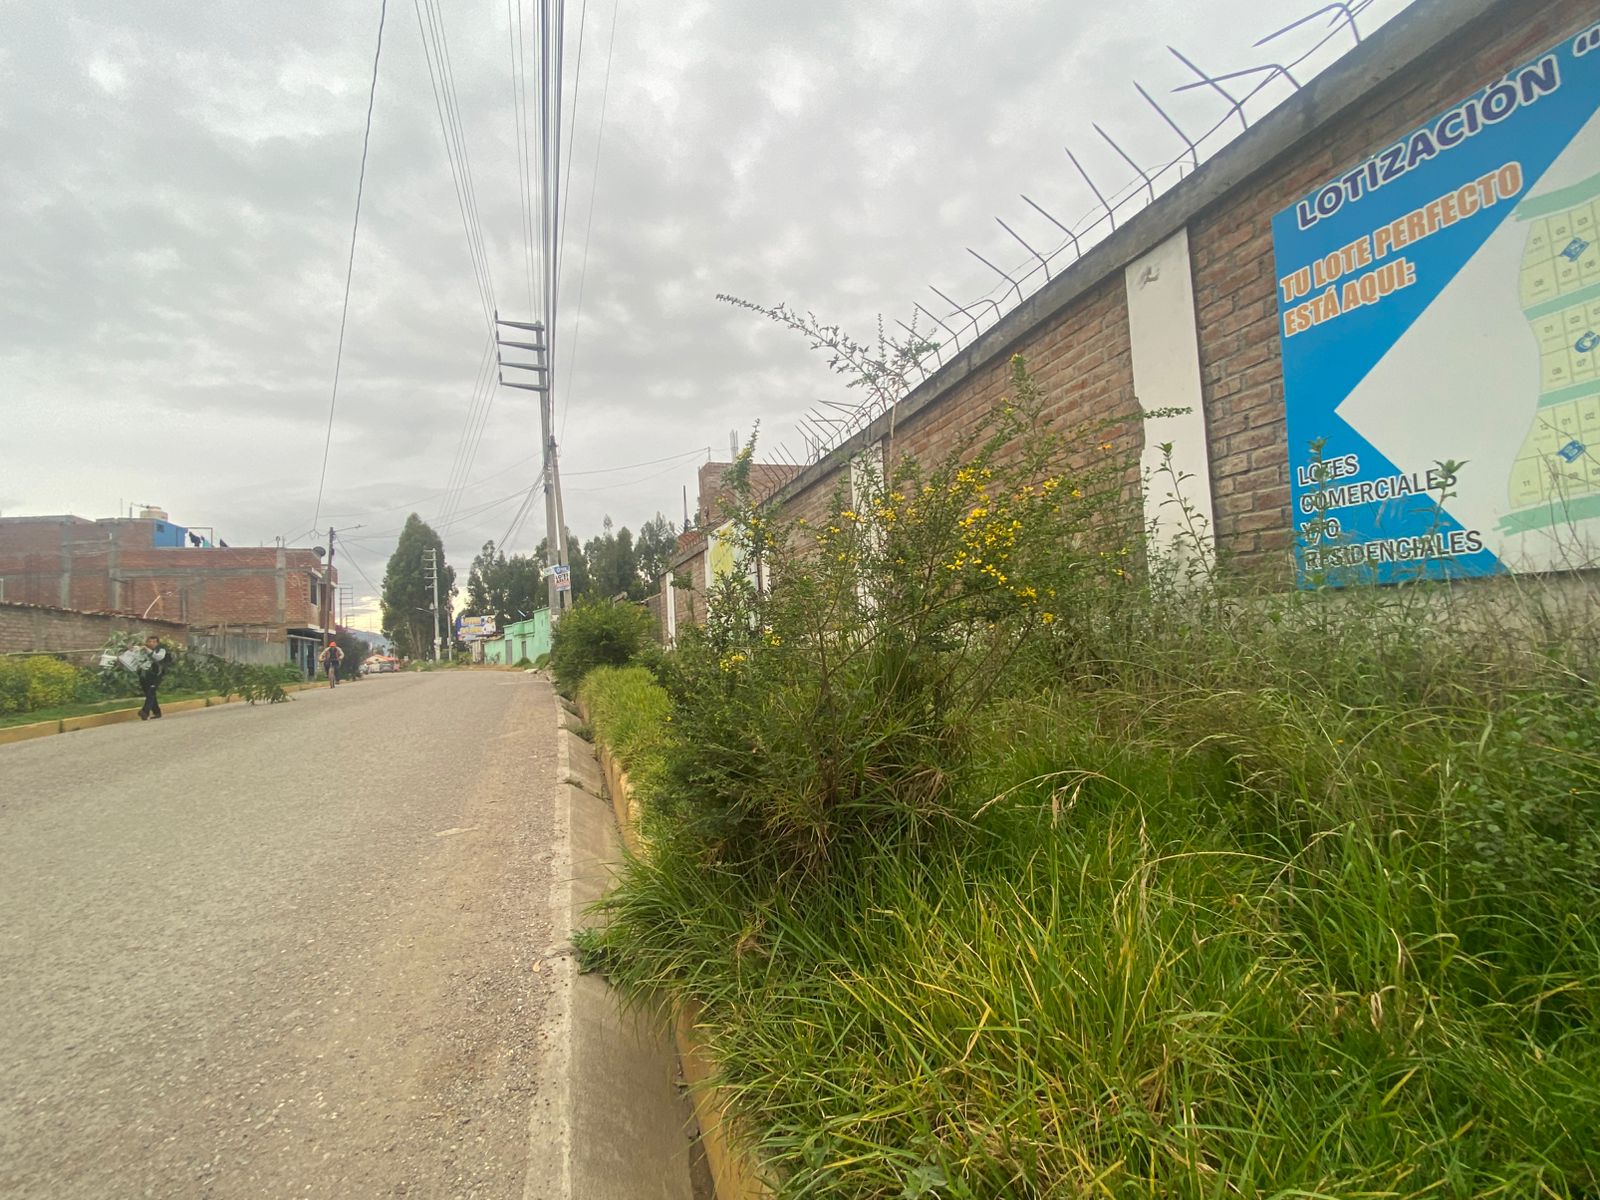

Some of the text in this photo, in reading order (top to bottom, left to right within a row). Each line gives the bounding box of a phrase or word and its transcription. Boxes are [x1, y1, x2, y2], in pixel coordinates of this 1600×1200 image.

[1298, 55, 1561, 231] LOTIZACIÓN
[1280, 161, 1523, 303] TU LOTE PERFECTO
[1283, 285, 1341, 337] ESTÁ
